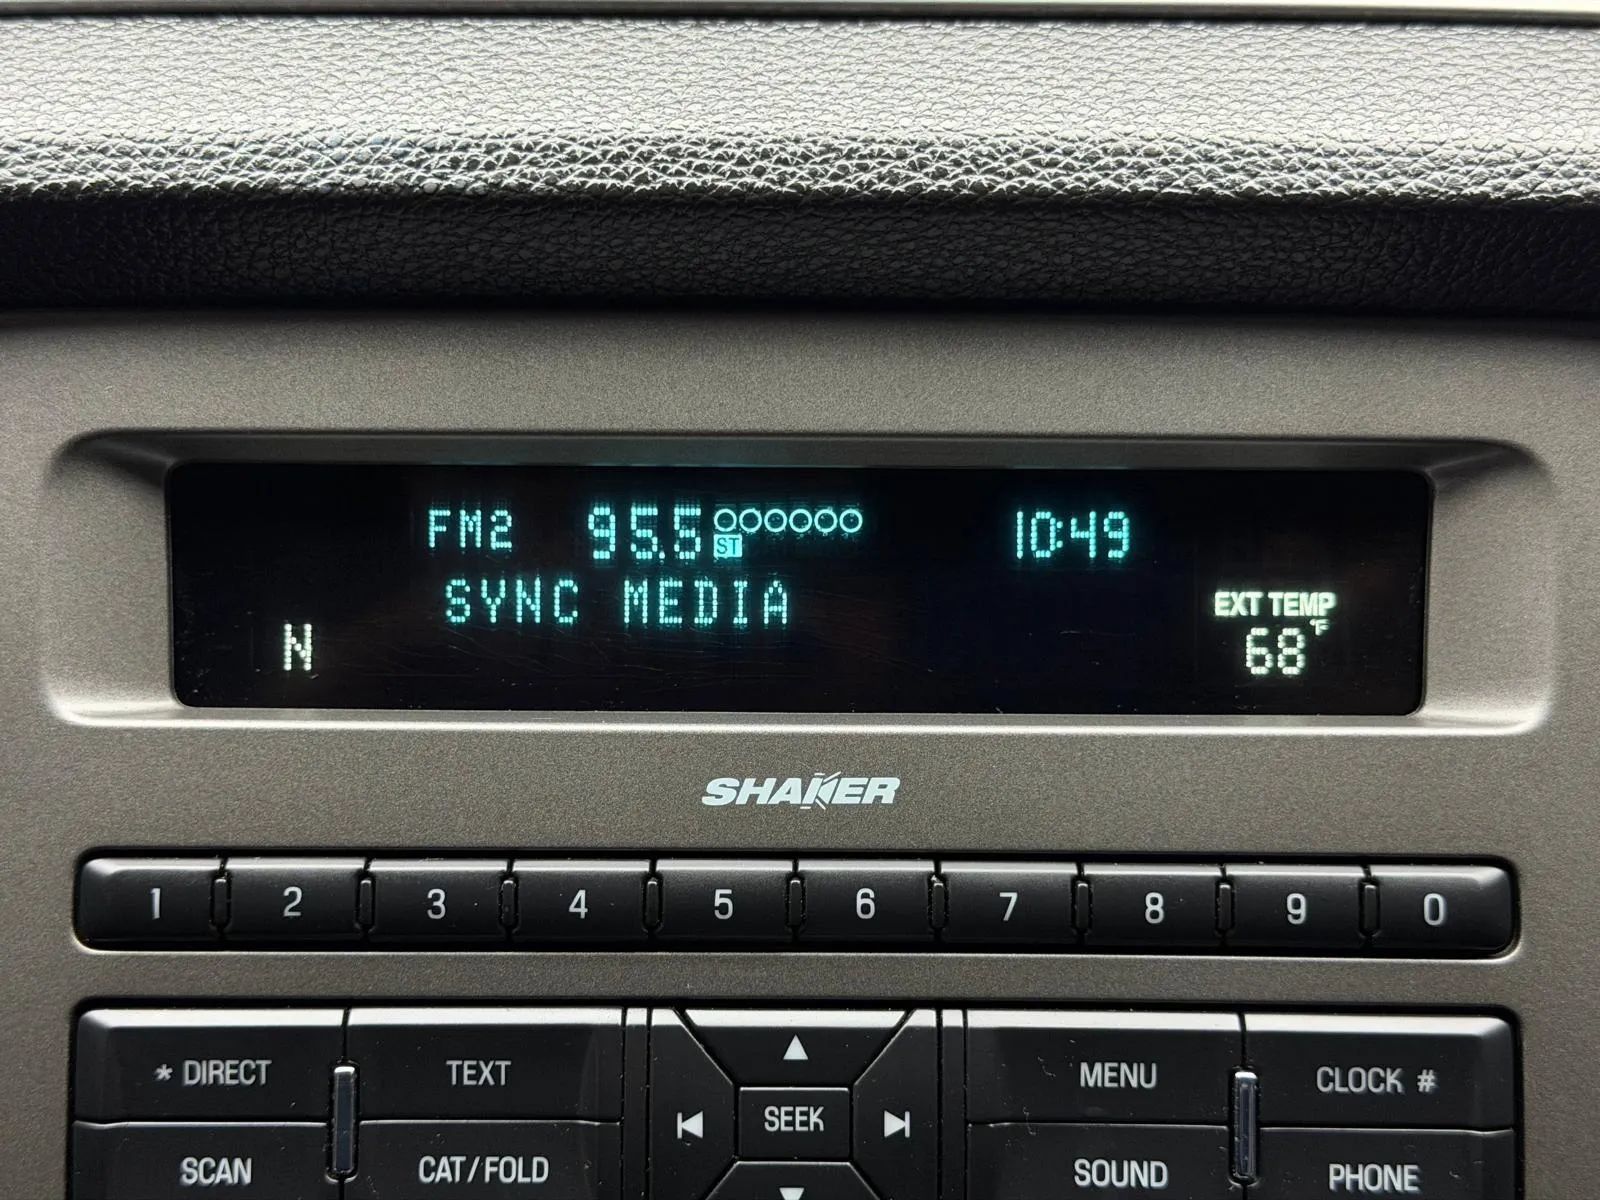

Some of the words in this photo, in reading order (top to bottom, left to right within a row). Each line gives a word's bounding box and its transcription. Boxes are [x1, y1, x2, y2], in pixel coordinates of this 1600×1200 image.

[429, 509, 512, 550] FM2
[587, 505, 701, 561] 95.5
[714, 535, 743, 558] ST
[1017, 511, 1129, 559] 10:49
[446, 577, 578, 625] SYNC
[624, 576, 787, 626] MEDIA
[1215, 590, 1262, 617] EXT
[1267, 591, 1337, 617] TEMP
[284, 624, 312, 671] N
[1246, 627, 1306, 675] 68
[701, 771, 901, 810] SHAKER
[150, 887, 162, 919] 1
[284, 887, 302, 916] 2
[428, 889, 445, 918] 3
[569, 890, 587, 918] 4
[715, 889, 733, 919] 5
[857, 888, 875, 918] 6
[1000, 892, 1017, 920] 7
[1146, 892, 1163, 923] 8
[1287, 893, 1306, 924] 9
[1424, 893, 1445, 925] 0
[185, 1060, 271, 1084] DIRECT
[447, 1061, 511, 1085] TEXT
[1081, 1063, 1156, 1088] MENU
[1317, 1067, 1404, 1093] CLOCK
[765, 1106, 823, 1131] SEEK
[182, 1157, 251, 1184] SCAN
[419, 1156, 548, 1183] CAT/FOLD
[1075, 1159, 1167, 1187] SOUND
[1329, 1163, 1420, 1192] PHONE
